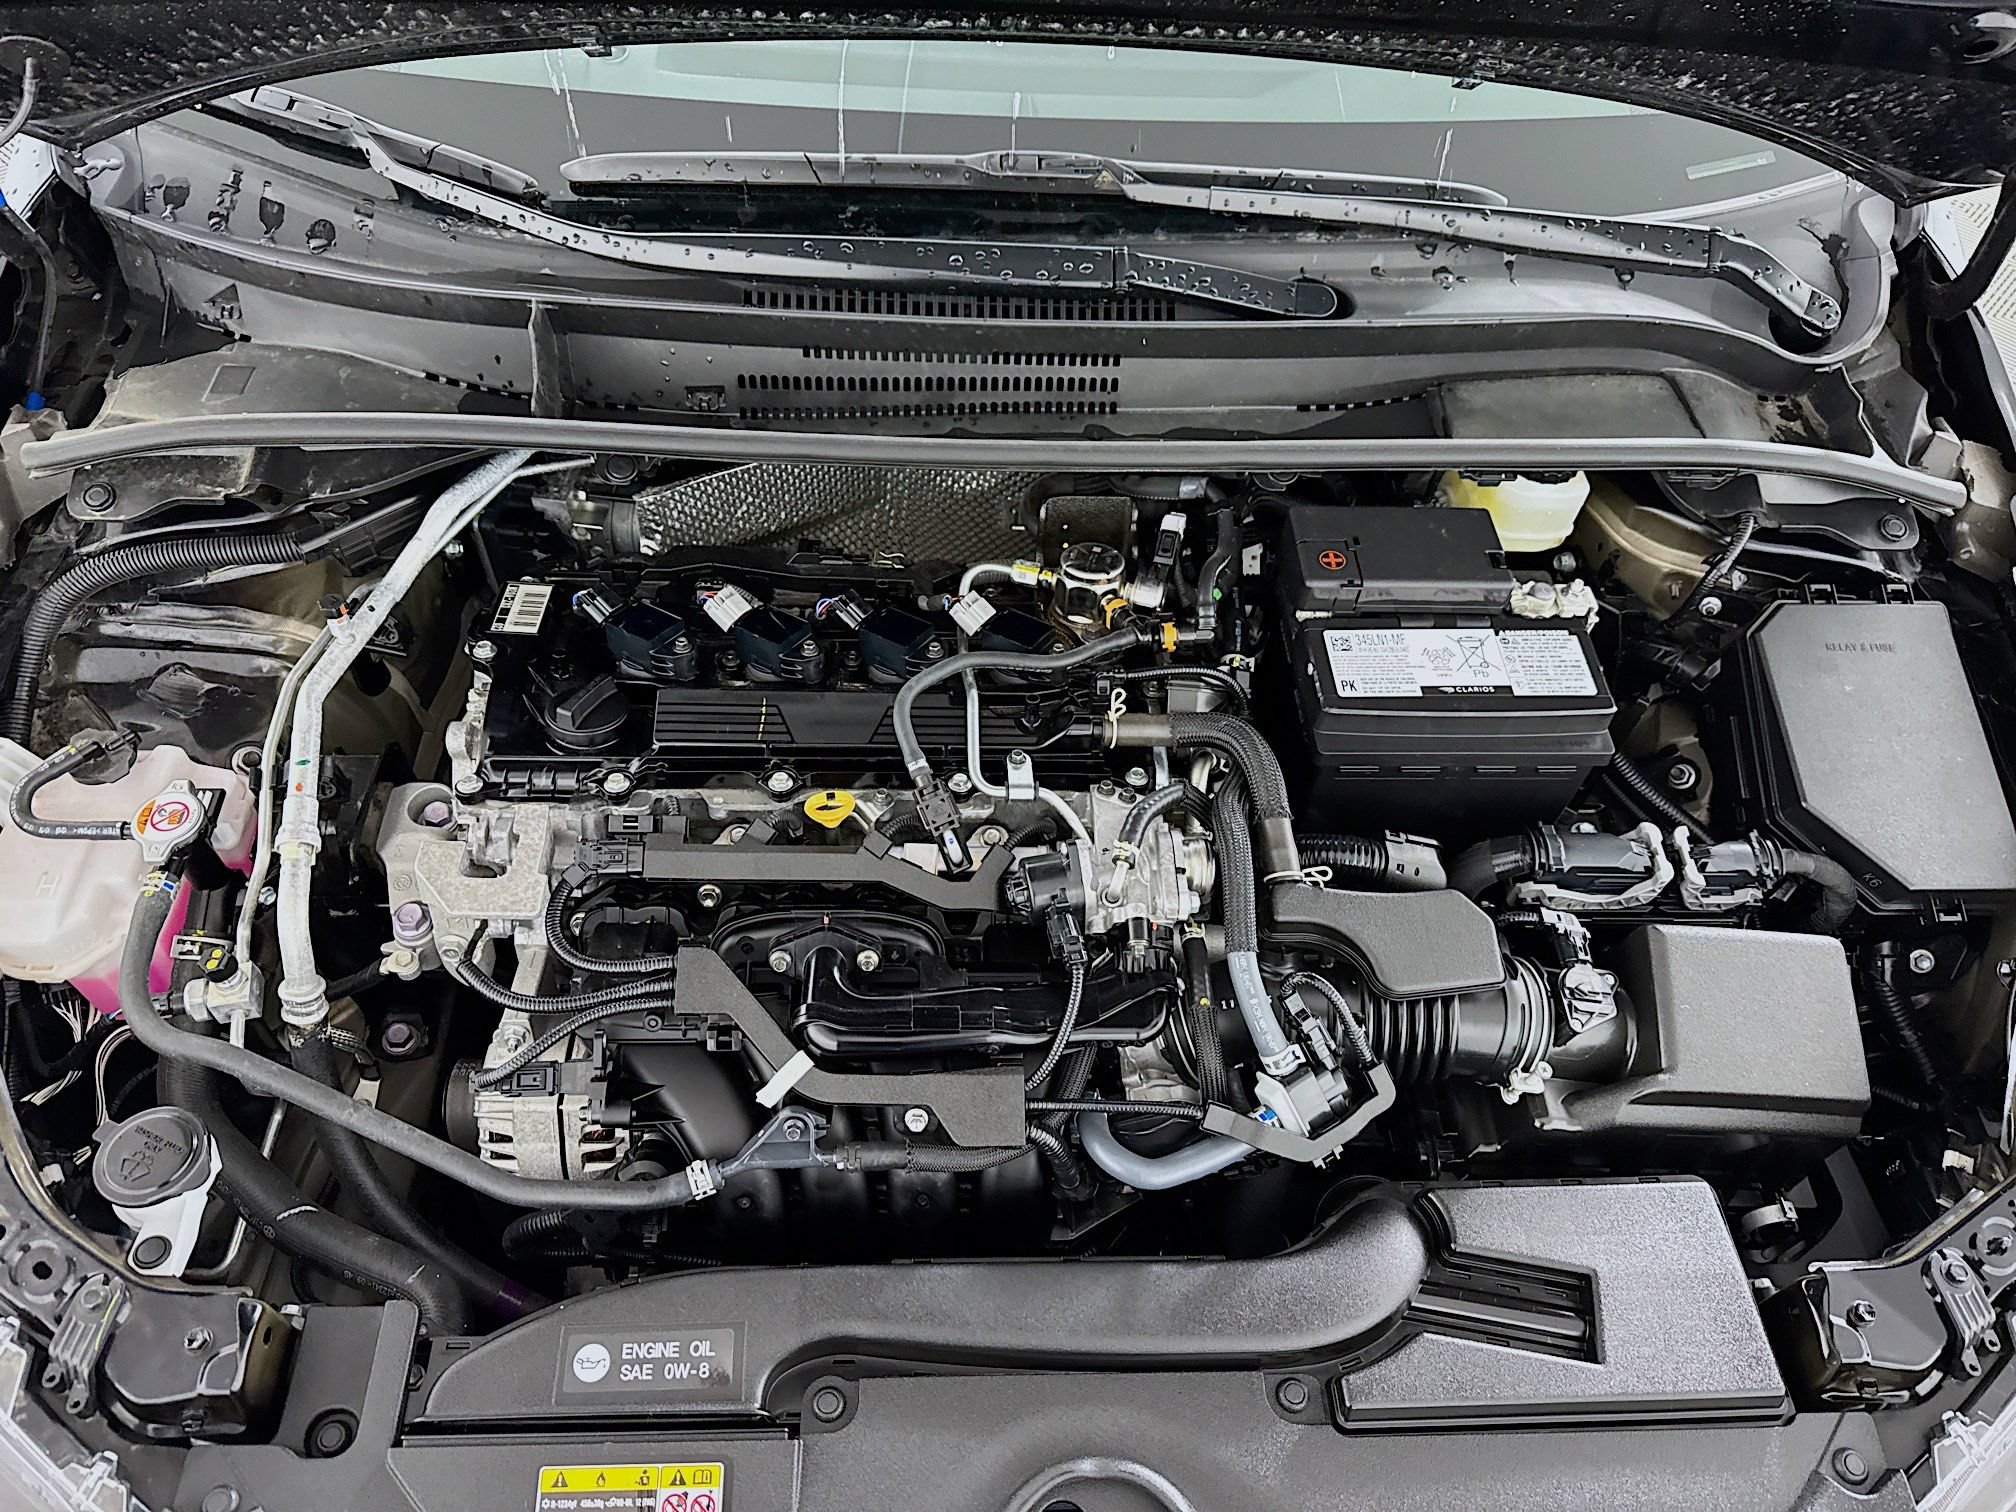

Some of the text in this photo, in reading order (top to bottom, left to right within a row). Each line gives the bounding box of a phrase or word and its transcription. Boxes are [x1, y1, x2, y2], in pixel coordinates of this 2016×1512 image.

[1355, 633, 1406, 646] 345LN1-MF
[1825, 643, 1896, 653] RELAY & FUSE
[1473, 669, 1489, 678] Pb
[1341, 680, 1358, 692] PK
[1863, 872, 1883, 888] K6
[621, 1340, 716, 1359] ENGINE OIL
[619, 1361, 710, 1381] SAE 0W-8
